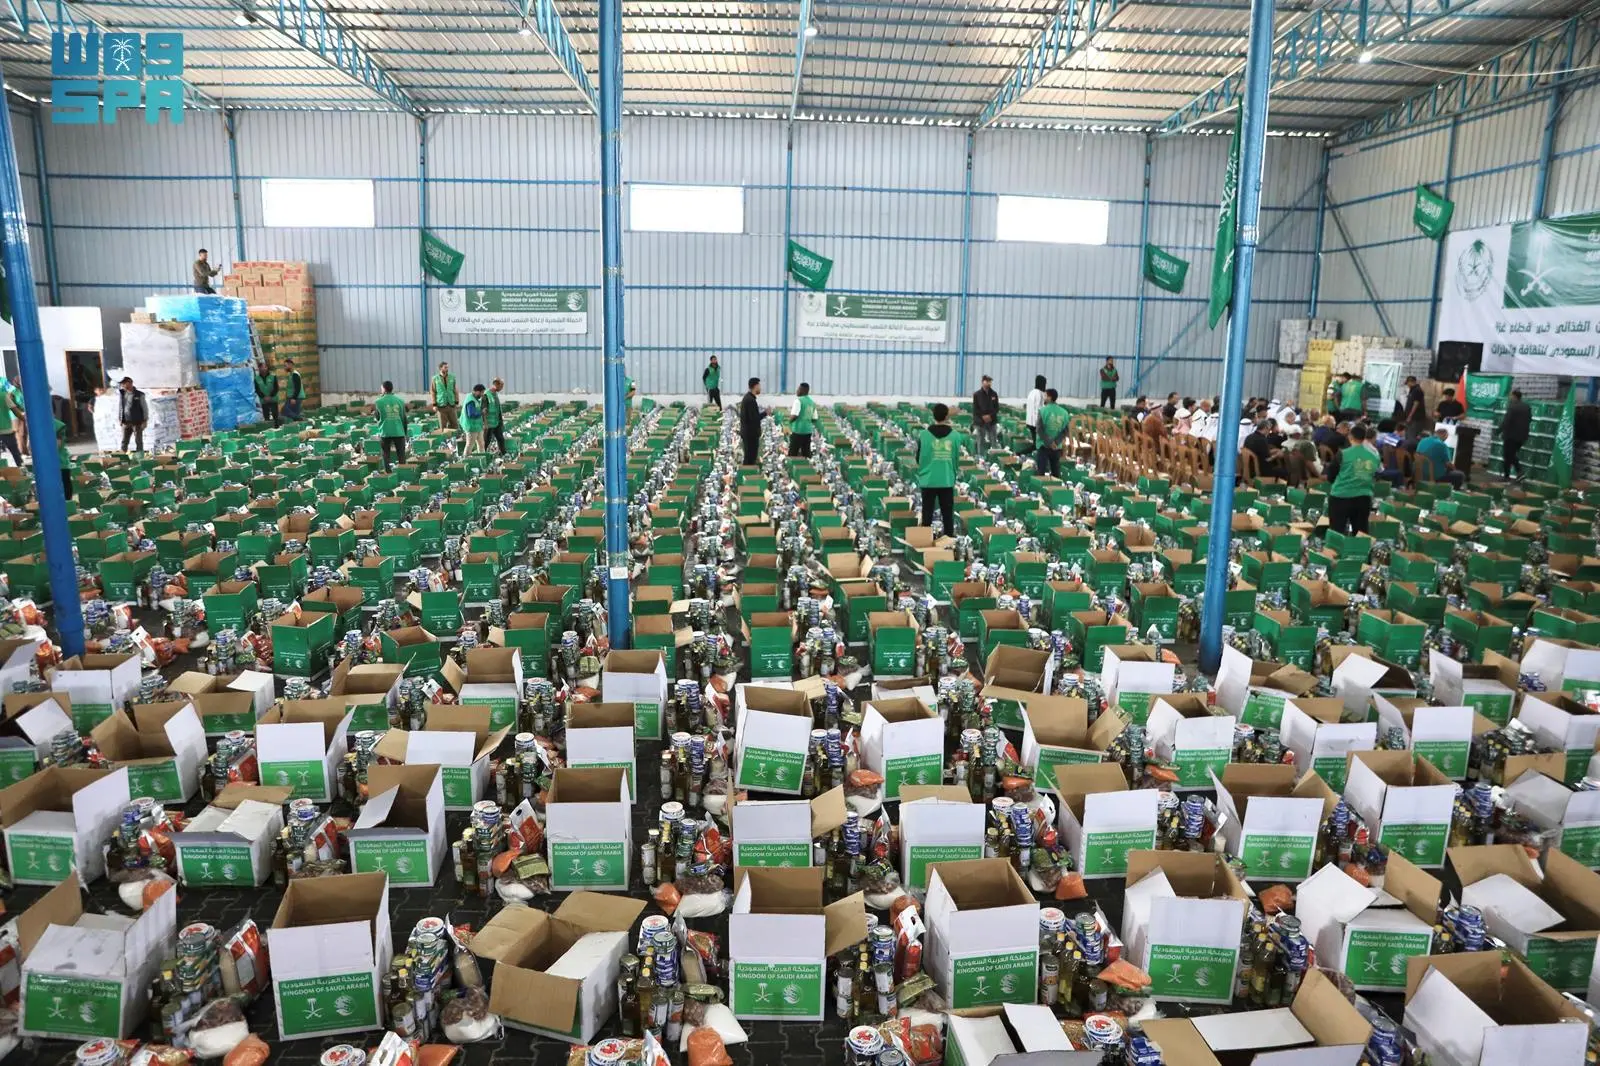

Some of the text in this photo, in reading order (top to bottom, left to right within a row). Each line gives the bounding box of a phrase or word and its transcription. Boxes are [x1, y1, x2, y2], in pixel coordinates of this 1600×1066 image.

[957, 966, 984, 974] KINGDOM
[283, 988, 314, 996] KINGDOM
[347, 982, 370, 990] ARABIA
